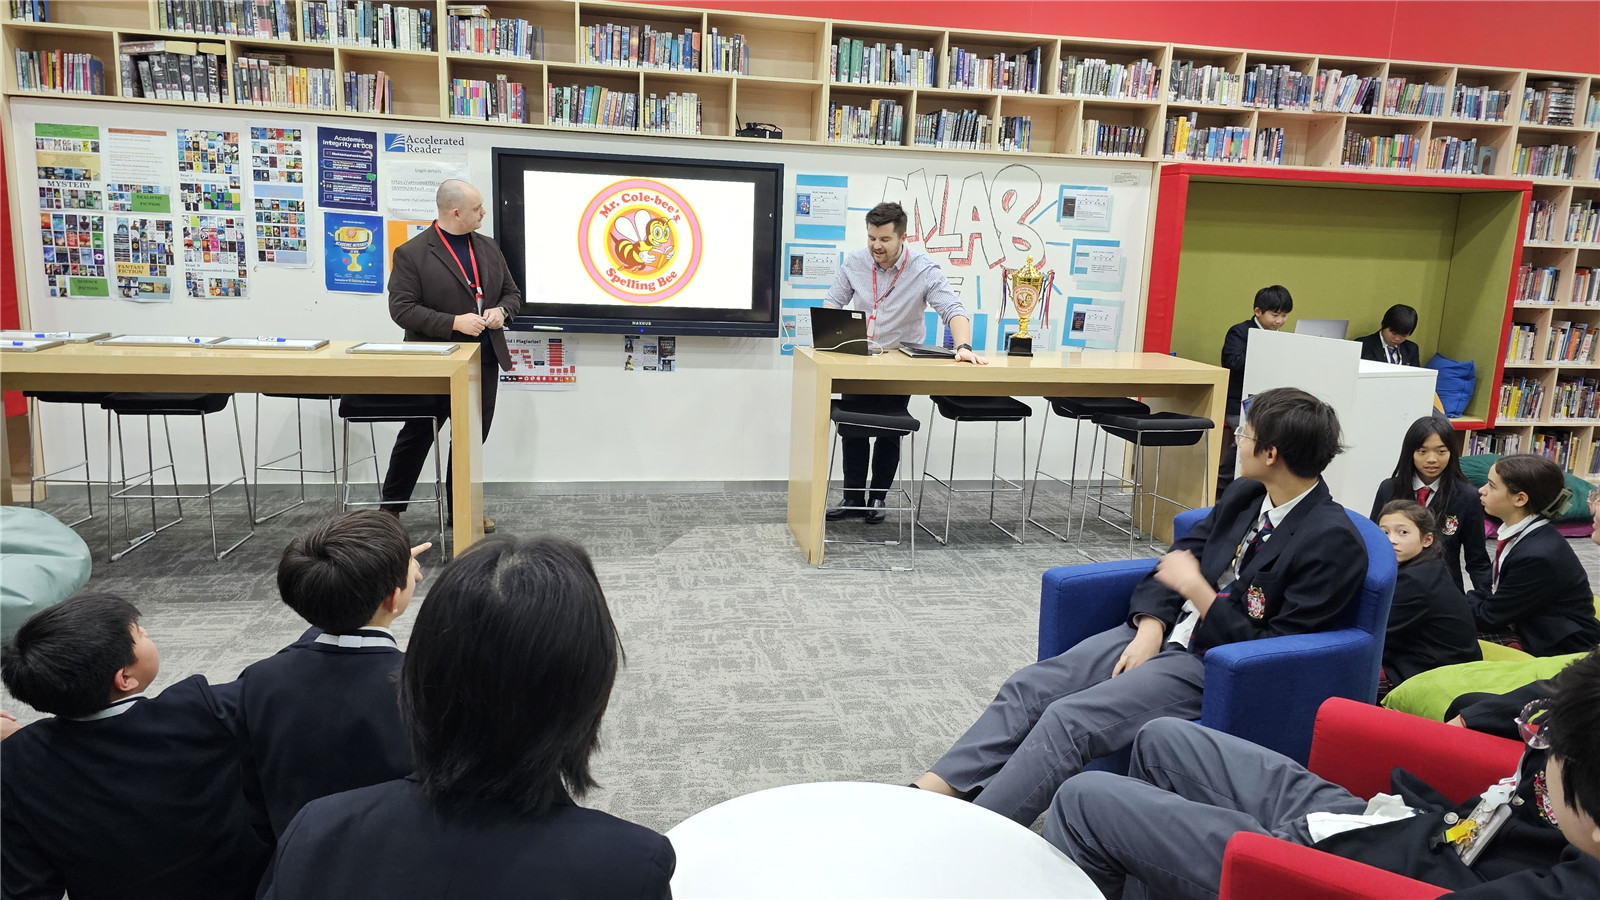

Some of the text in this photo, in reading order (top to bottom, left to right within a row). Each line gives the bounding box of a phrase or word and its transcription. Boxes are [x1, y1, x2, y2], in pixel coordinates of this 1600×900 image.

[322, 139, 352, 149] Integrity
[334, 135, 365, 143] Academic
[405, 134, 465, 146] Accelerated
[407, 143, 442, 154] Reader
[47, 180, 92, 189] MYSTERY
[599, 192, 681, 223] Mr. Cole-bee's
[606, 267, 678, 292] Spelling Bee
